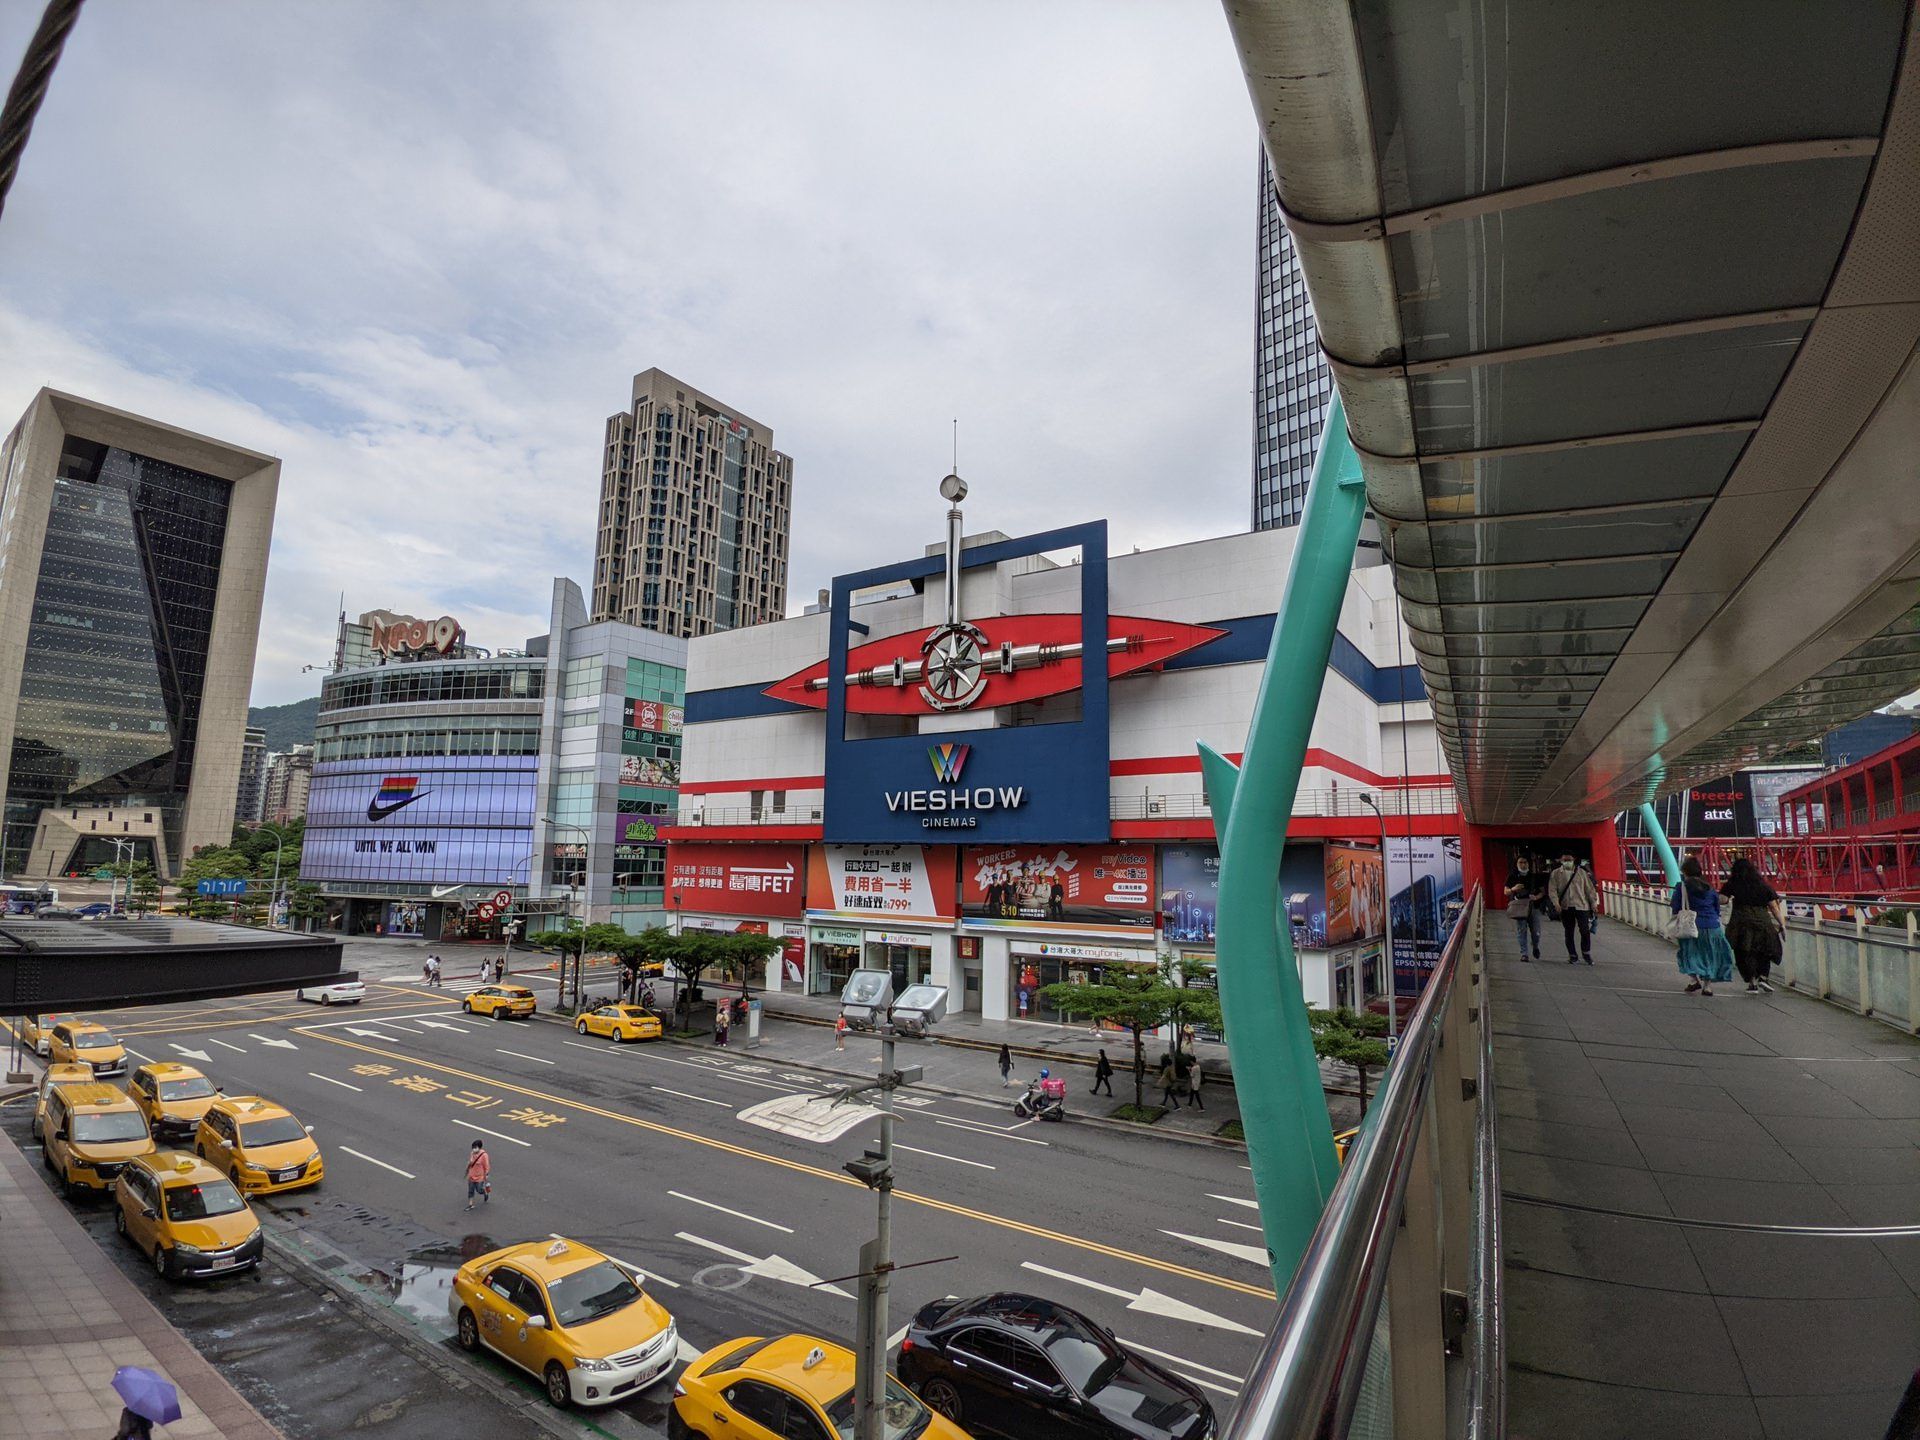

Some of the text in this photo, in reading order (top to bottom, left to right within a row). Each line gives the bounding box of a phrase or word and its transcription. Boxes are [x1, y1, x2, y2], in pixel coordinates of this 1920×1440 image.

[624, 707, 635, 716] 2F
[885, 786, 1023, 812] VIESHOW
[1691, 791, 1744, 801] Breeze
[1704, 808, 1733, 820] atré
[922, 816, 976, 828] CINEMAS
[355, 840, 436, 854] UNTIL WE ALL WIN
[977, 848, 1017, 866] WORKERS
[1102, 854, 1147, 867] myVideo
[845, 876, 912, 893] 費用省一半
[844, 895, 883, 909] 好速成双
[826, 930, 858, 939] VIESHOW
[888, 935, 917, 943] myfone
[1049, 946, 1123, 958] 台灣大哥大 myfone
[1387, 1036, 1398, 1051] P
[547, 1278, 562, 1288] 2900
